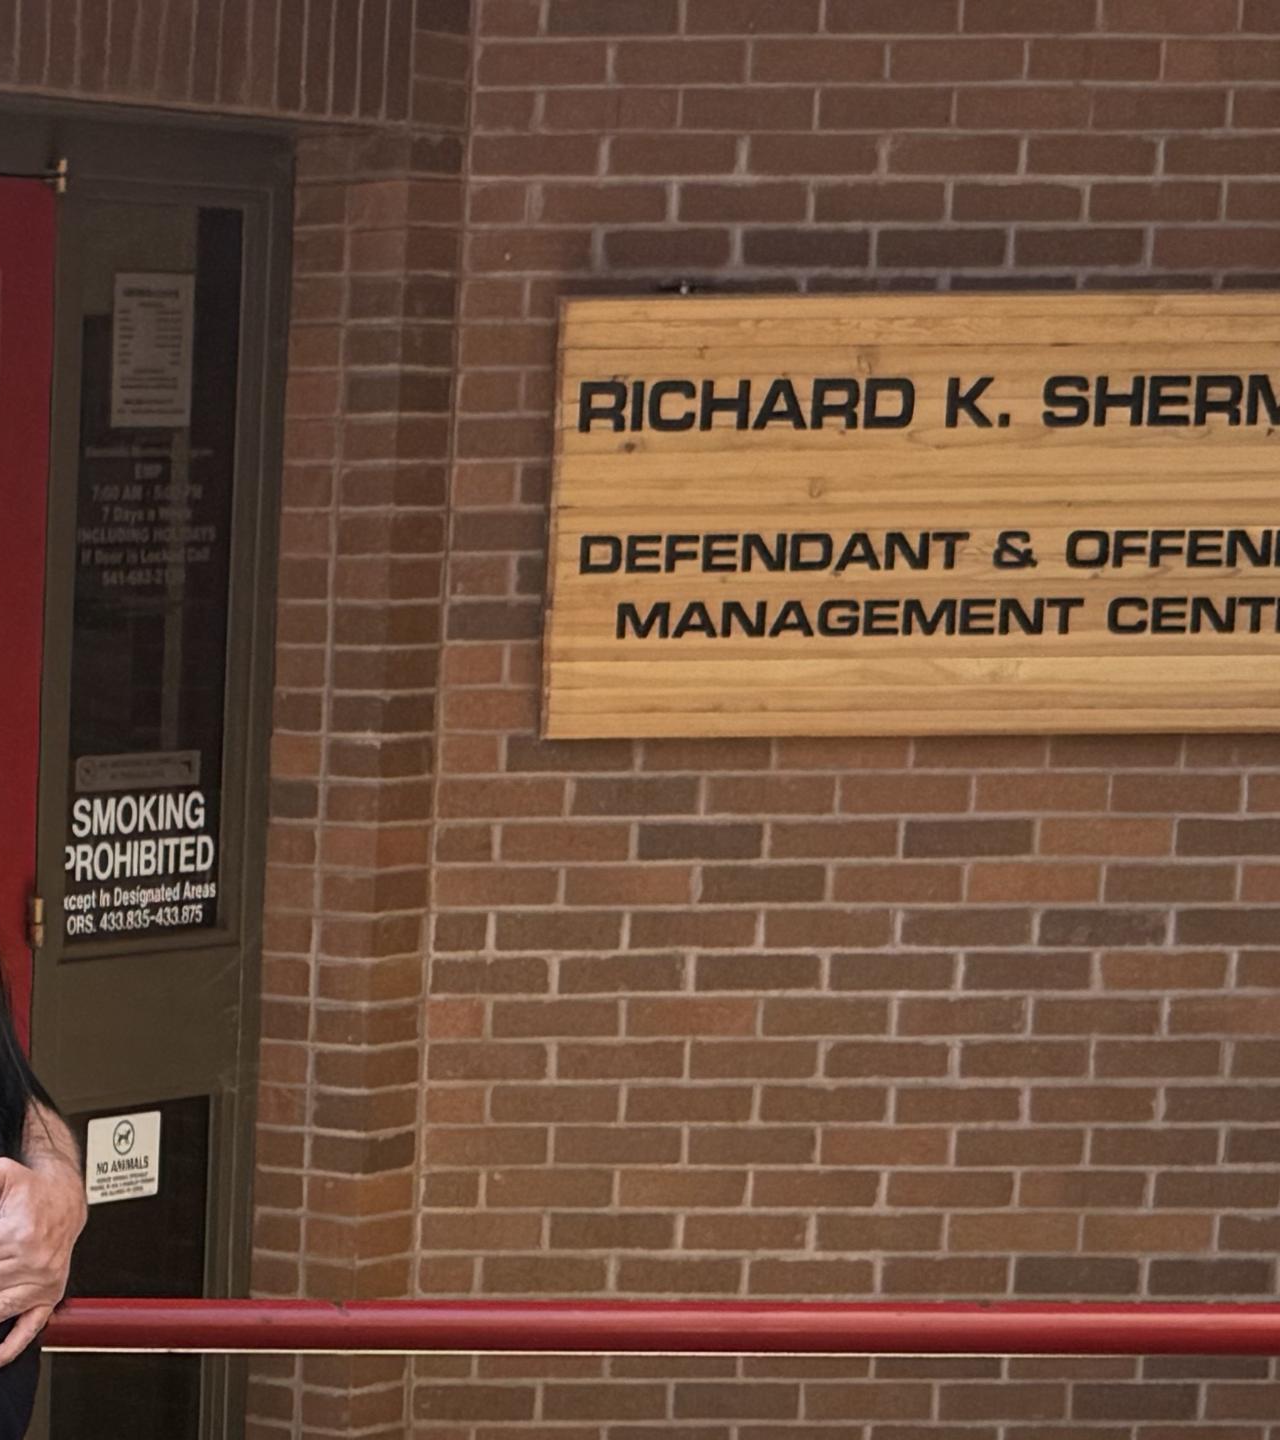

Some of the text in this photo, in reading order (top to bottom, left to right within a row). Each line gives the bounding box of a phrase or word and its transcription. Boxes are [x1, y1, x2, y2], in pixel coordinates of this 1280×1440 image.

[577, 378, 915, 432] RICHARD
[945, 376, 1011, 428] K.
[101, 506, 110, 522] 7
[113, 506, 144, 525] Days
[77, 526, 150, 543] INCLUDING
[579, 529, 1280, 574] DEFENDANT & OFFEN
[615, 596, 1280, 639] MANAGEMENT CENT
[71, 791, 205, 838] SMOKING
[64, 835, 214, 882] PROHIBITED
[114, 883, 180, 909] Designated
[183, 881, 216, 900] Areas
[66, 914, 96, 936] ORS.
[96, 1155, 149, 1176] NO ANIMALS
